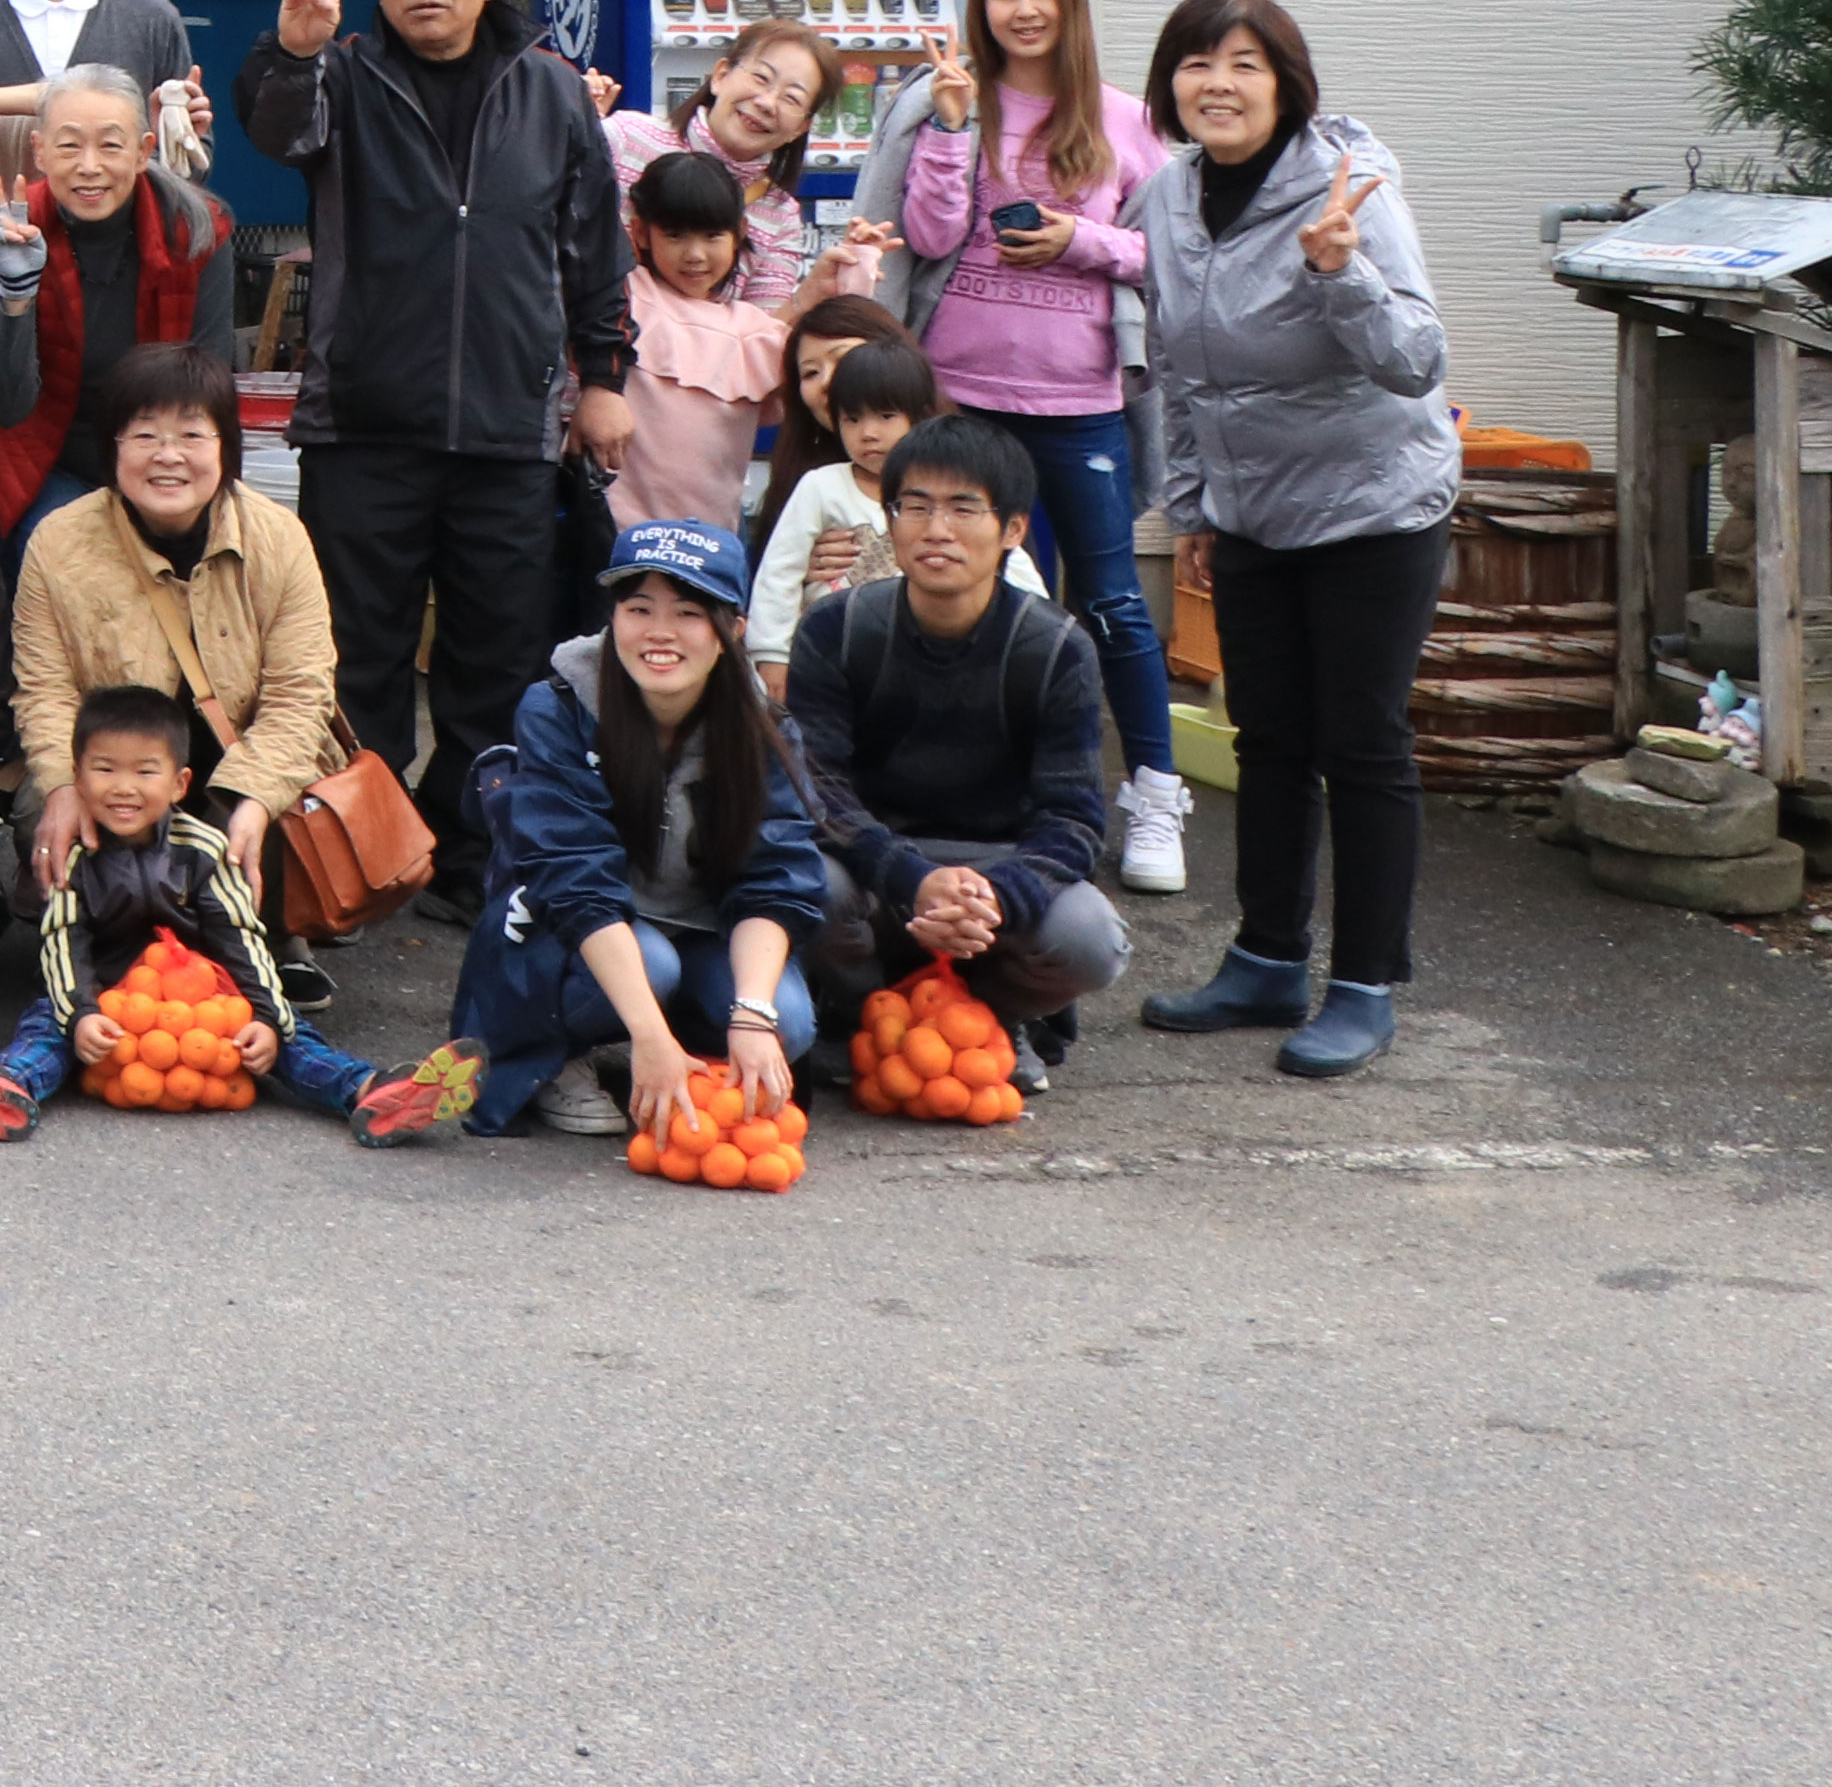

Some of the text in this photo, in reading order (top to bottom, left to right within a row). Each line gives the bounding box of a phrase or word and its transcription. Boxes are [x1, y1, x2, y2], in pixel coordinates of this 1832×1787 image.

[631, 526, 721, 553] EVERYTHING
[656, 538, 677, 550] IS
[635, 548, 705, 571] PRACTICE
